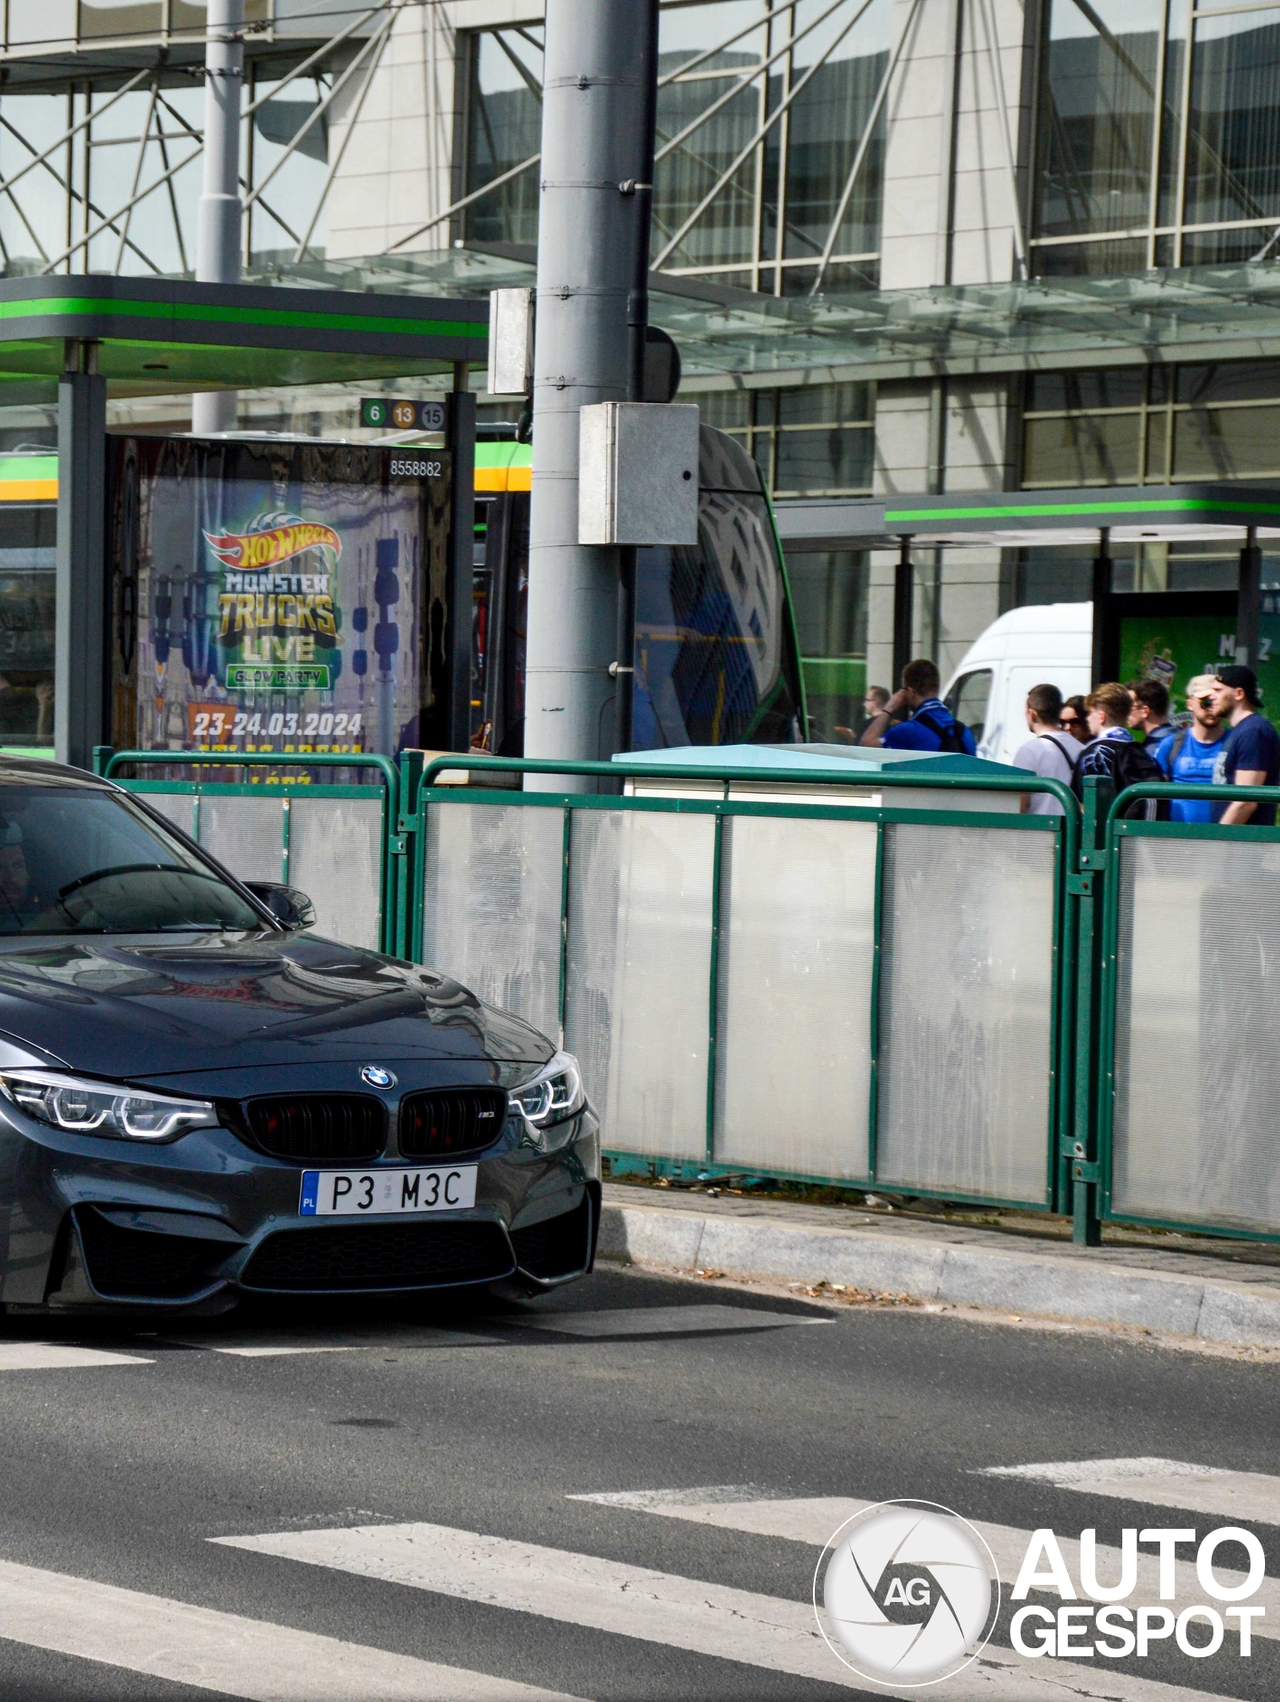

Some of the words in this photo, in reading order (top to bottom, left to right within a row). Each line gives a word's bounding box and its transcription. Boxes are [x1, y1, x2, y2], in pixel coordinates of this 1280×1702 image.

[370, 405, 380, 421] 6
[395, 407, 413, 423] 13
[424, 409, 441, 424] 15
[390, 460, 441, 477] 8558882
[223, 572, 331, 593] MONSTER
[217, 593, 340, 639] TRUCKS
[242, 635, 315, 662] LIVE
[235, 670, 276, 684] GLOW
[276, 669, 321, 683] PARTY
[192, 712, 363, 737] 23-24.03.2024
[303, 1198, 315, 1208] PL
[332, 1175, 375, 1211] P3
[401, 1171, 462, 1208] M3C
